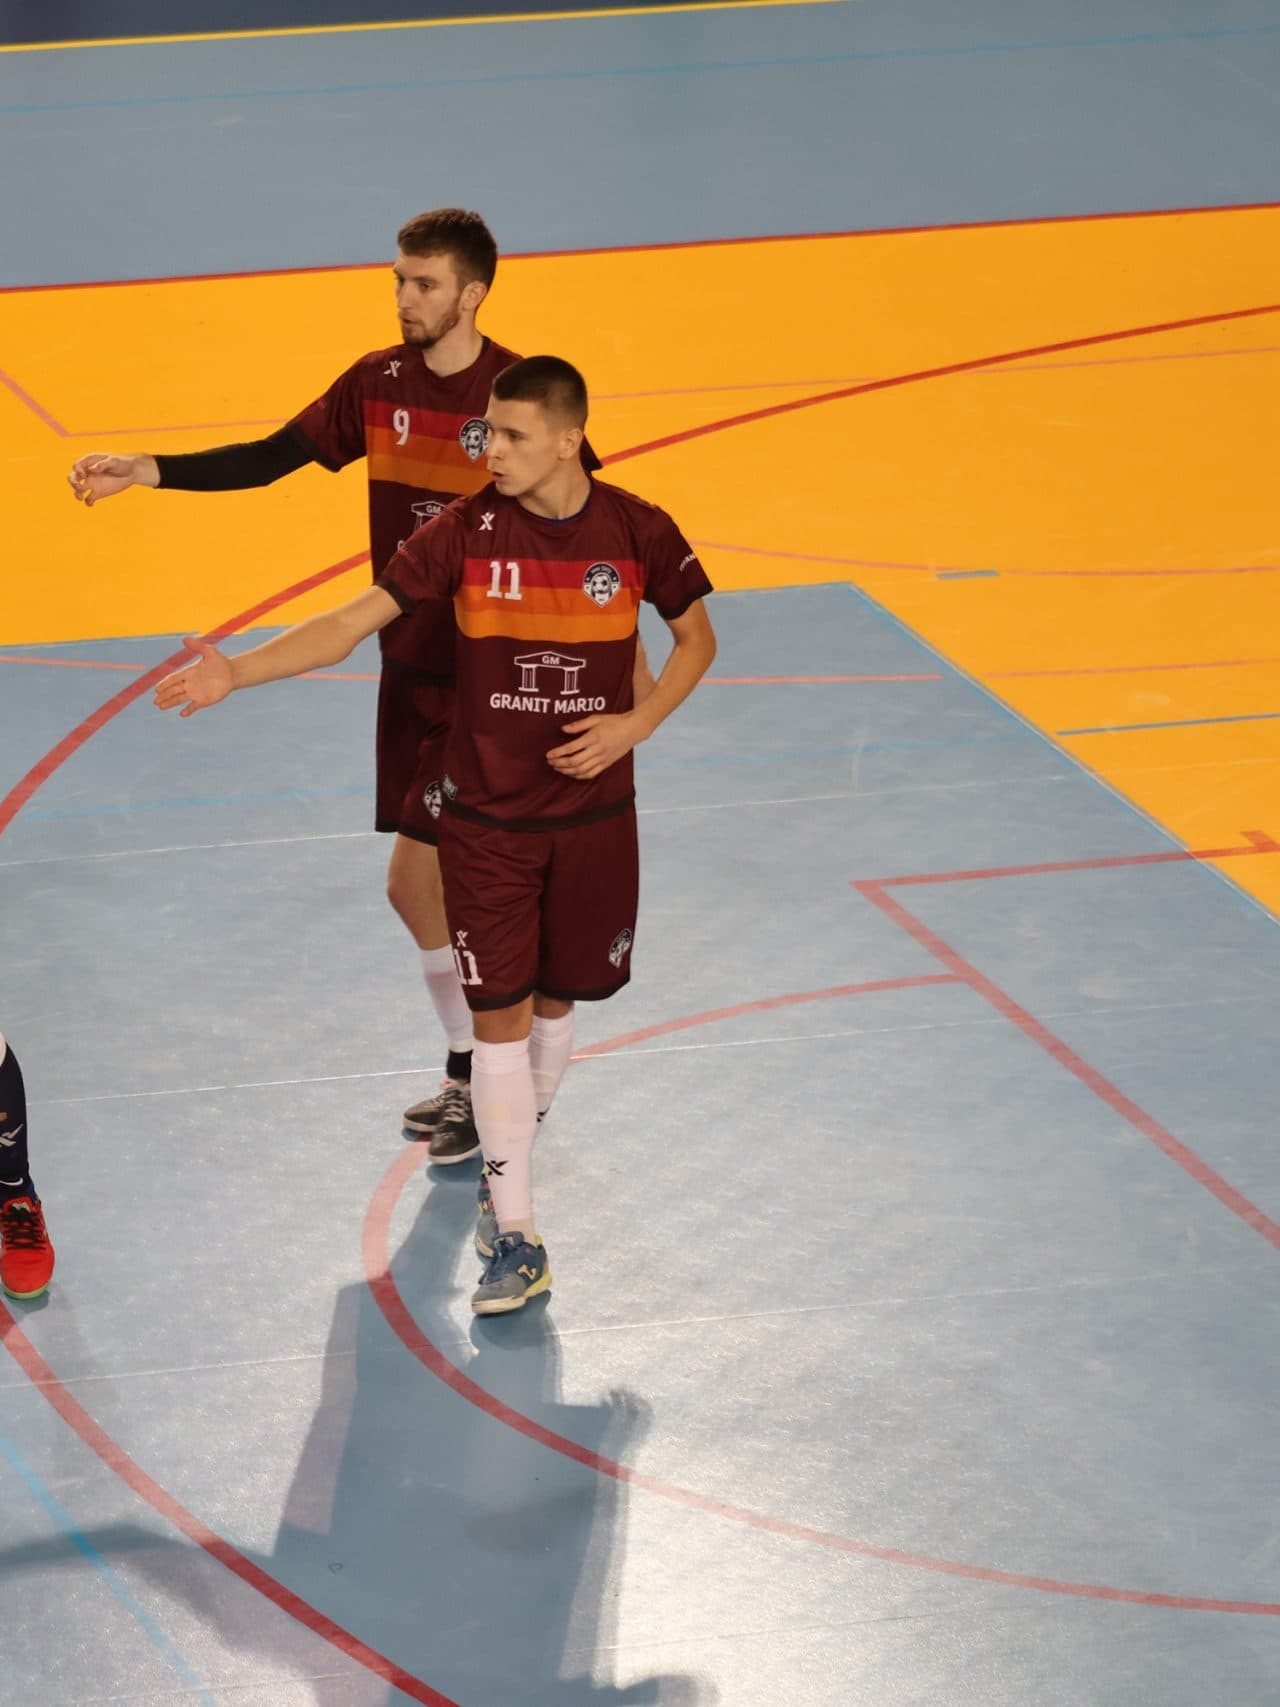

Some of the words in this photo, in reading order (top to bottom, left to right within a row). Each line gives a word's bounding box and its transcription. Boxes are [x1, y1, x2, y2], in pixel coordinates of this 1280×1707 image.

[392, 408, 411, 446] 9
[486, 560, 522, 600] 11
[541, 654, 560, 666] GM
[489, 692, 550, 714] GRANIT
[553, 696, 607, 715] MARIO
